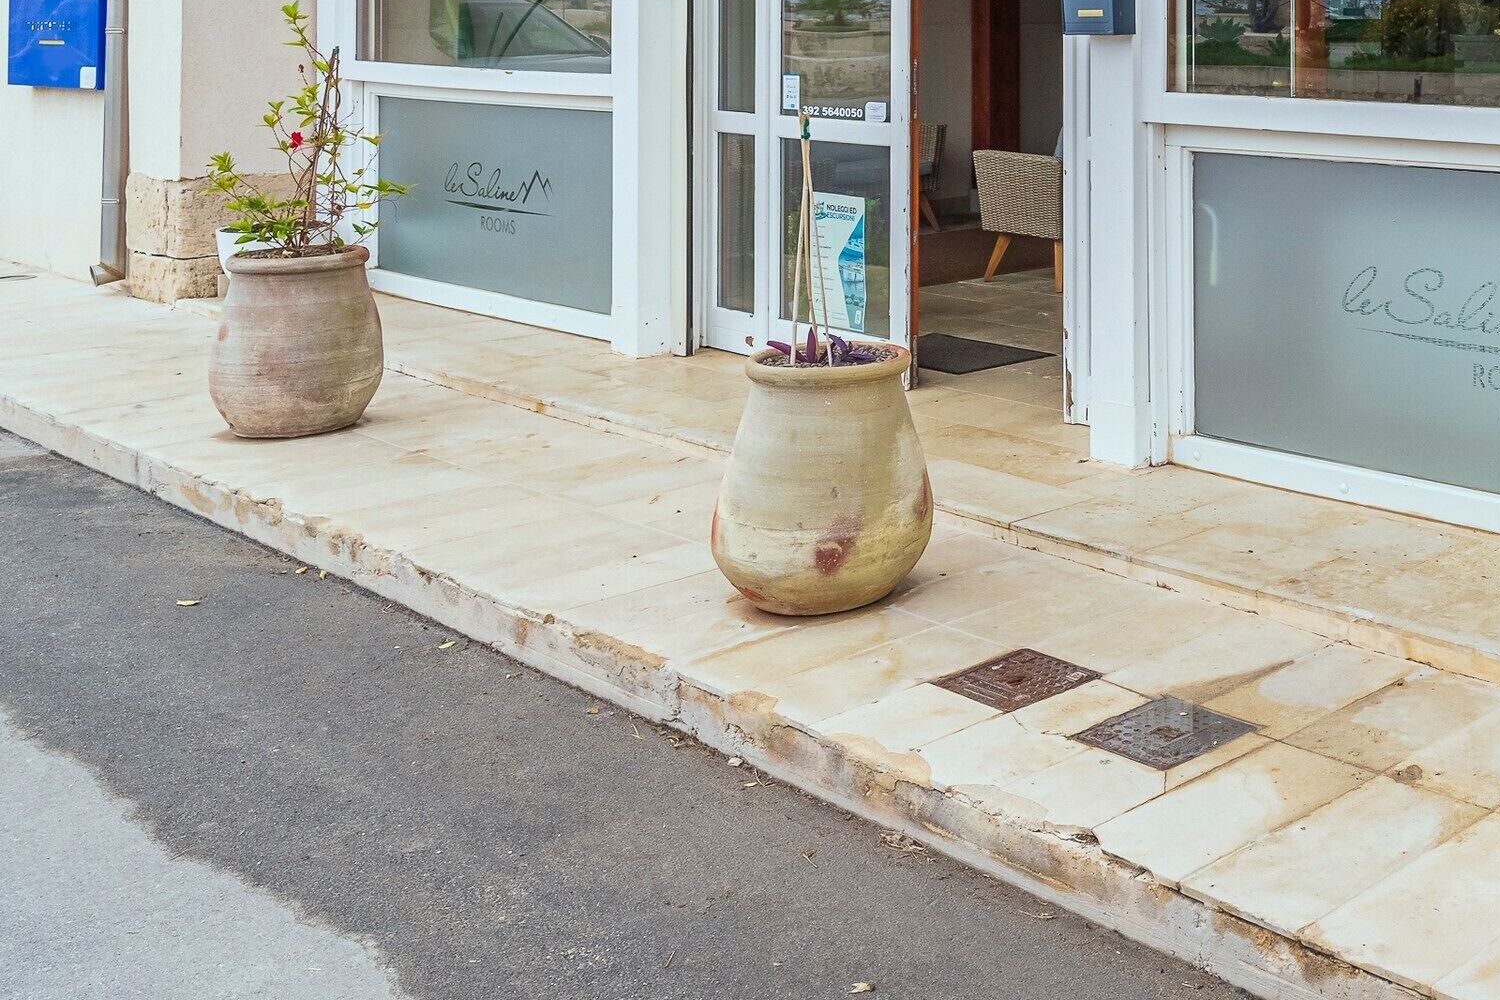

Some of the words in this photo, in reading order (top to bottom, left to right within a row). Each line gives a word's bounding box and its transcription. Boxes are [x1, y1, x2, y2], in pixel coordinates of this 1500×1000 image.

[802, 105, 820, 116] 392
[821, 106, 863, 118] 5640050
[444, 162, 460, 193] le
[460, 161, 517, 202] Saline
[849, 206, 858, 215] ED
[480, 215, 516, 235] ROOMS
[1342, 264, 1384, 316] le
